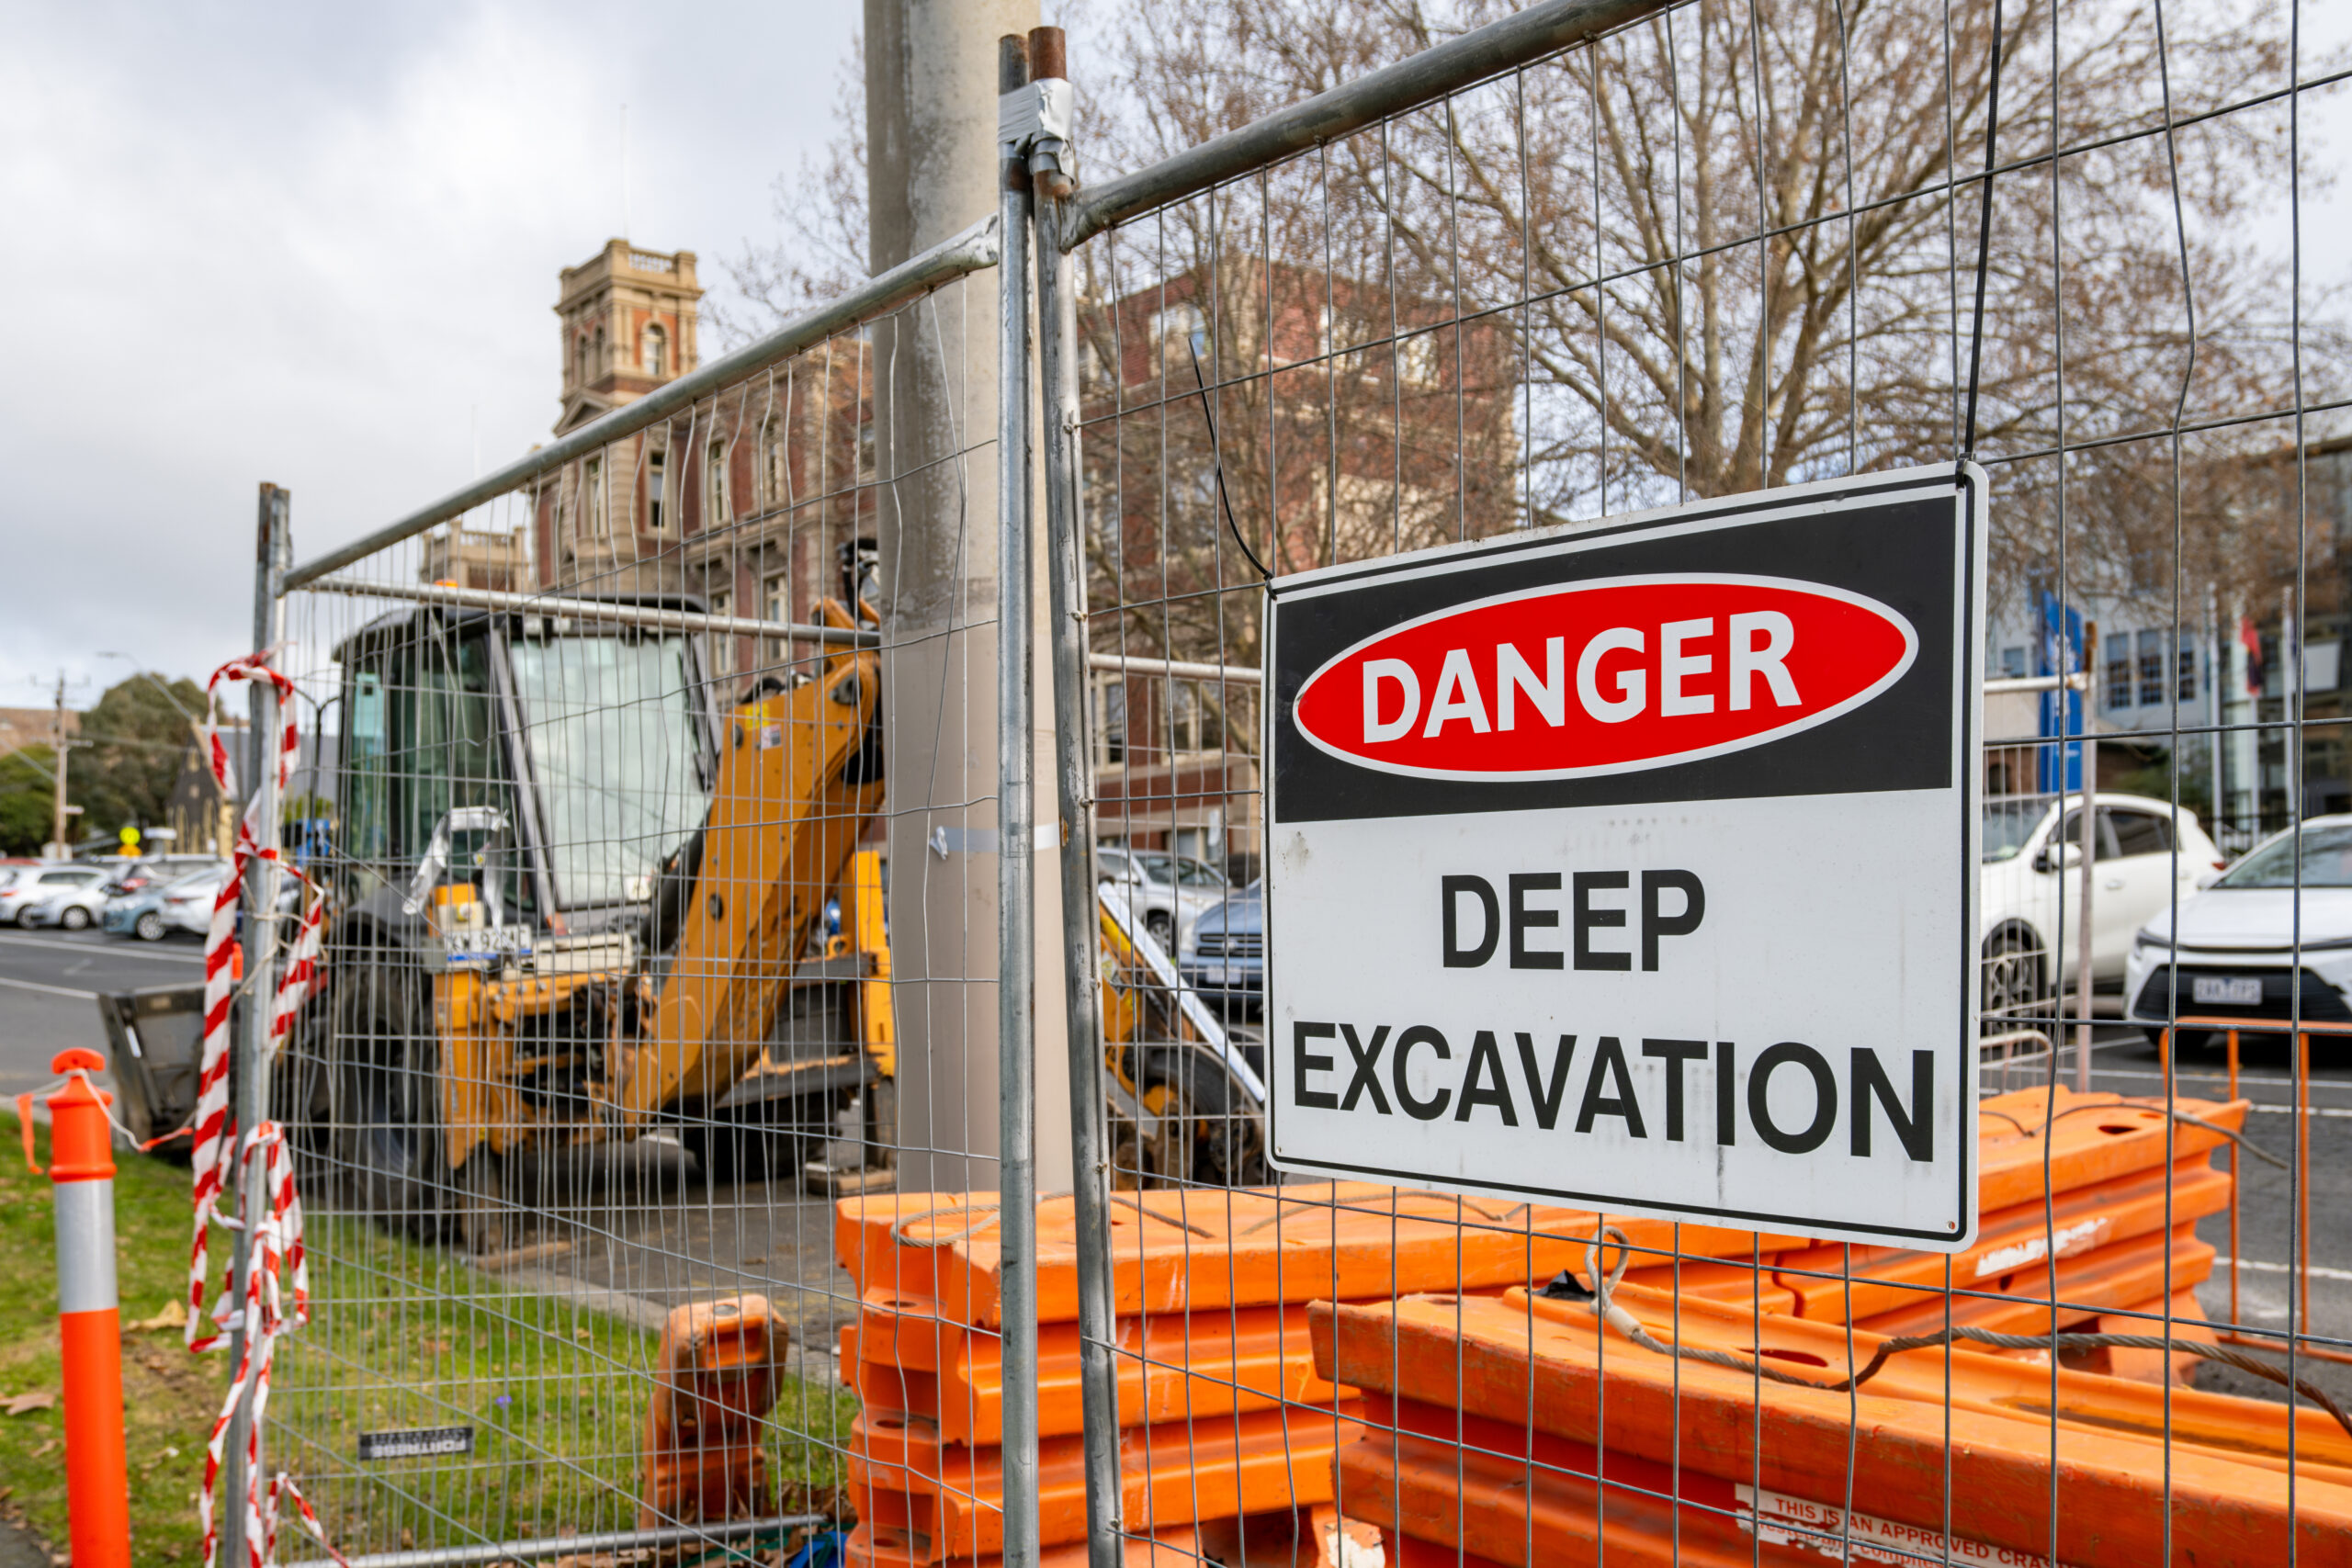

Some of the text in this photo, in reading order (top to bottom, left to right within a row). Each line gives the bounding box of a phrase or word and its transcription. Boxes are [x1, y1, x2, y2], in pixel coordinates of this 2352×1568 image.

[1362, 610, 1802, 744] DANGER
[1442, 869, 1706, 972] DEEP
[1293, 1021, 1934, 1163] EXCAVATION
[1775, 1498, 1816, 1520] THIS
[1823, 1507, 1841, 1525] IS
[1849, 1516, 1873, 1533] AN
[1880, 1522, 1989, 1560] APPROVED
